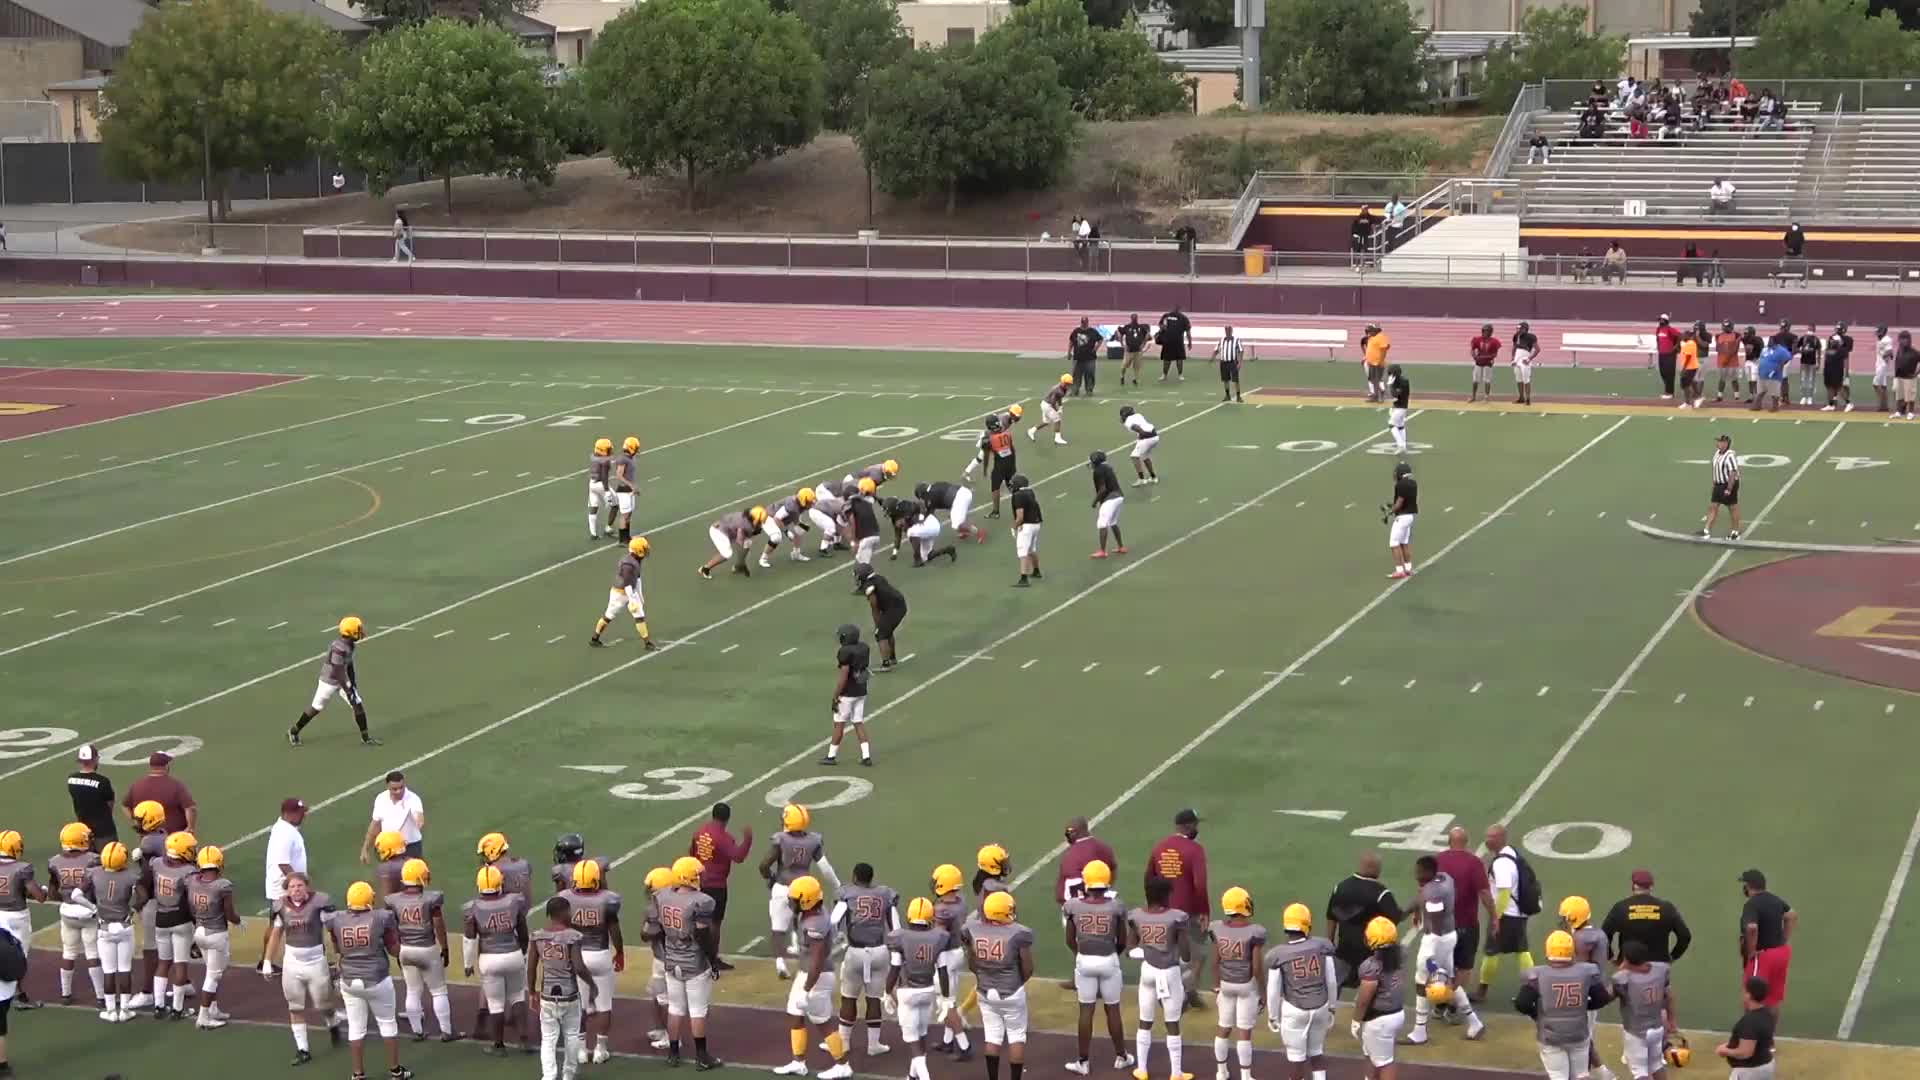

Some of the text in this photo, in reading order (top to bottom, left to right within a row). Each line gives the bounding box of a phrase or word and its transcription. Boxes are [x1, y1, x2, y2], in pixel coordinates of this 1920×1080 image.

[60, 867, 85, 888] 26
[156, 874, 175, 897] 16
[107, 879, 116, 901] 1
[400, 904, 423, 926] 44
[485, 910, 512, 934] 45
[571, 908, 600, 927] 49
[661, 906, 684, 929] 66
[1079, 914, 1111, 935] 25
[341, 924, 371, 949] 65
[1140, 925, 1168, 945] 22
[915, 942, 935, 962] 41
[975, 937, 1005, 961] 64
[1219, 936, 1245, 961] 24
[1291, 954, 1322, 981] 54
[1551, 982, 1583, 1009] 75
